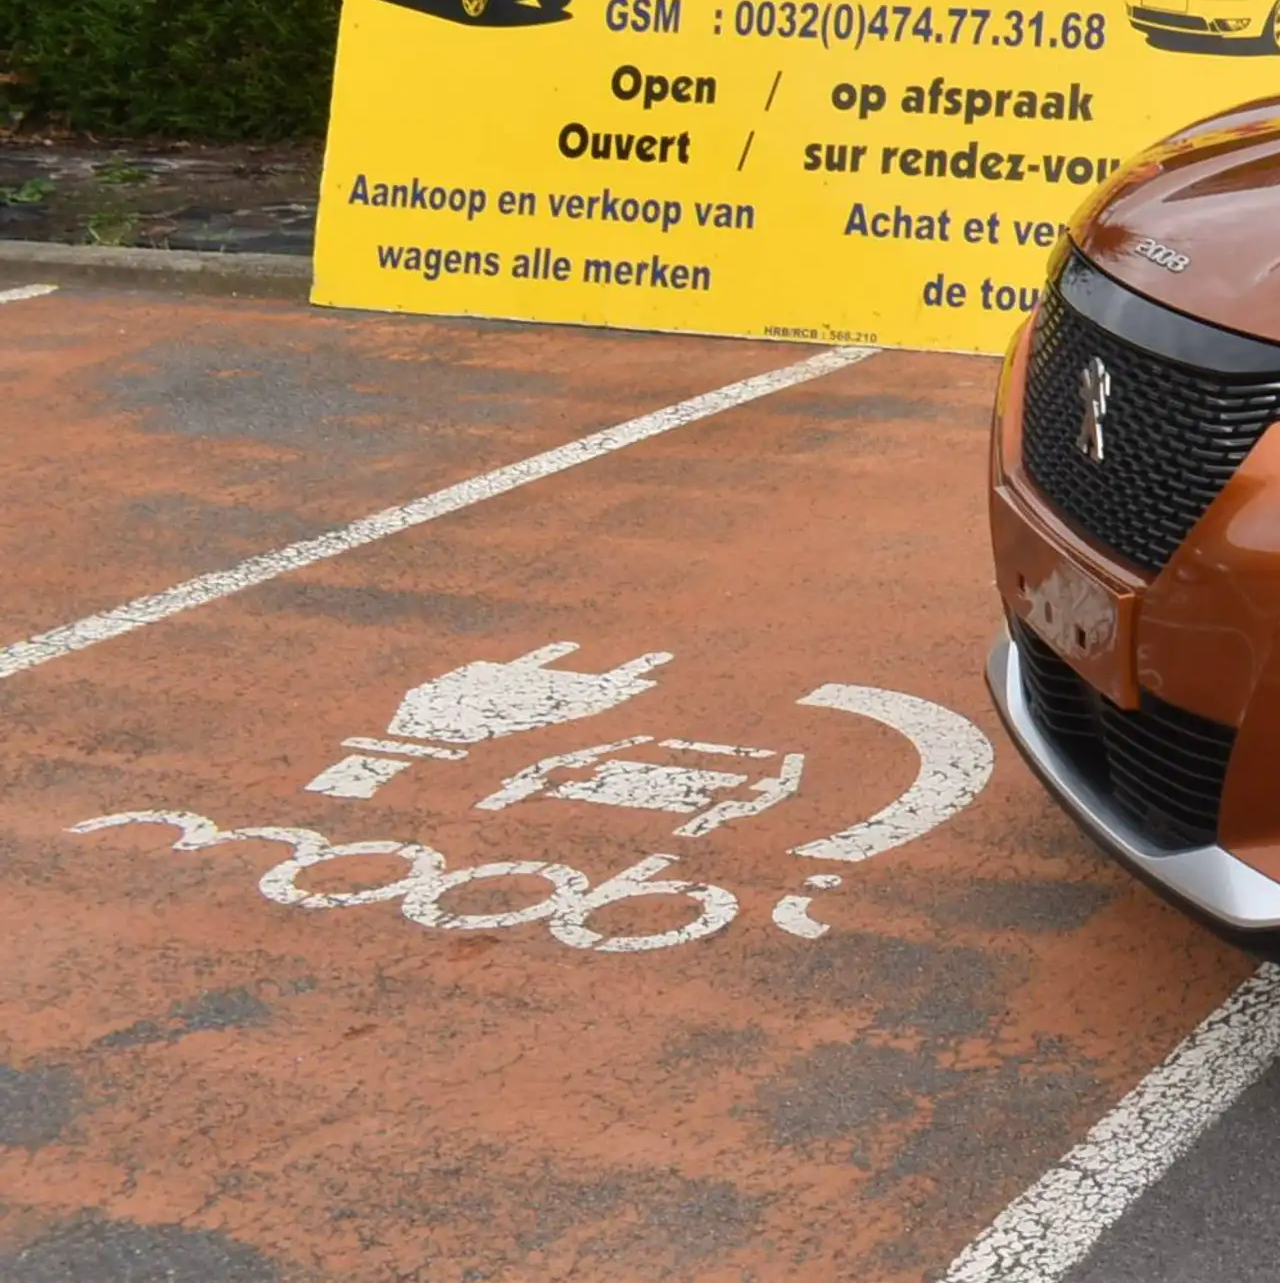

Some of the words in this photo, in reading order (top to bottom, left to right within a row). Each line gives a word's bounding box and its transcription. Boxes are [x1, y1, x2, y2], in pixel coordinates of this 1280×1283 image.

[735, 0, 1105, 51] 0032(0)474.77.31.68
[611, 64, 716, 110] Open
[831, 82, 887, 120] op
[900, 76, 1093, 125] afspraak
[558, 122, 691, 164] Ouvert
[803, 143, 868, 173] sur
[348, 174, 486, 221] Aankoop
[497, 190, 536, 216] en
[548, 188, 682, 233] verkoop
[694, 202, 754, 230] van
[843, 202, 951, 242] Achat
[963, 212, 1000, 245] et
[377, 245, 500, 281] wagens
[511, 247, 571, 282] alle
[583, 254, 711, 291] merken
[1135, 238, 1190, 272] 2008
[923, 273, 967, 308] de
